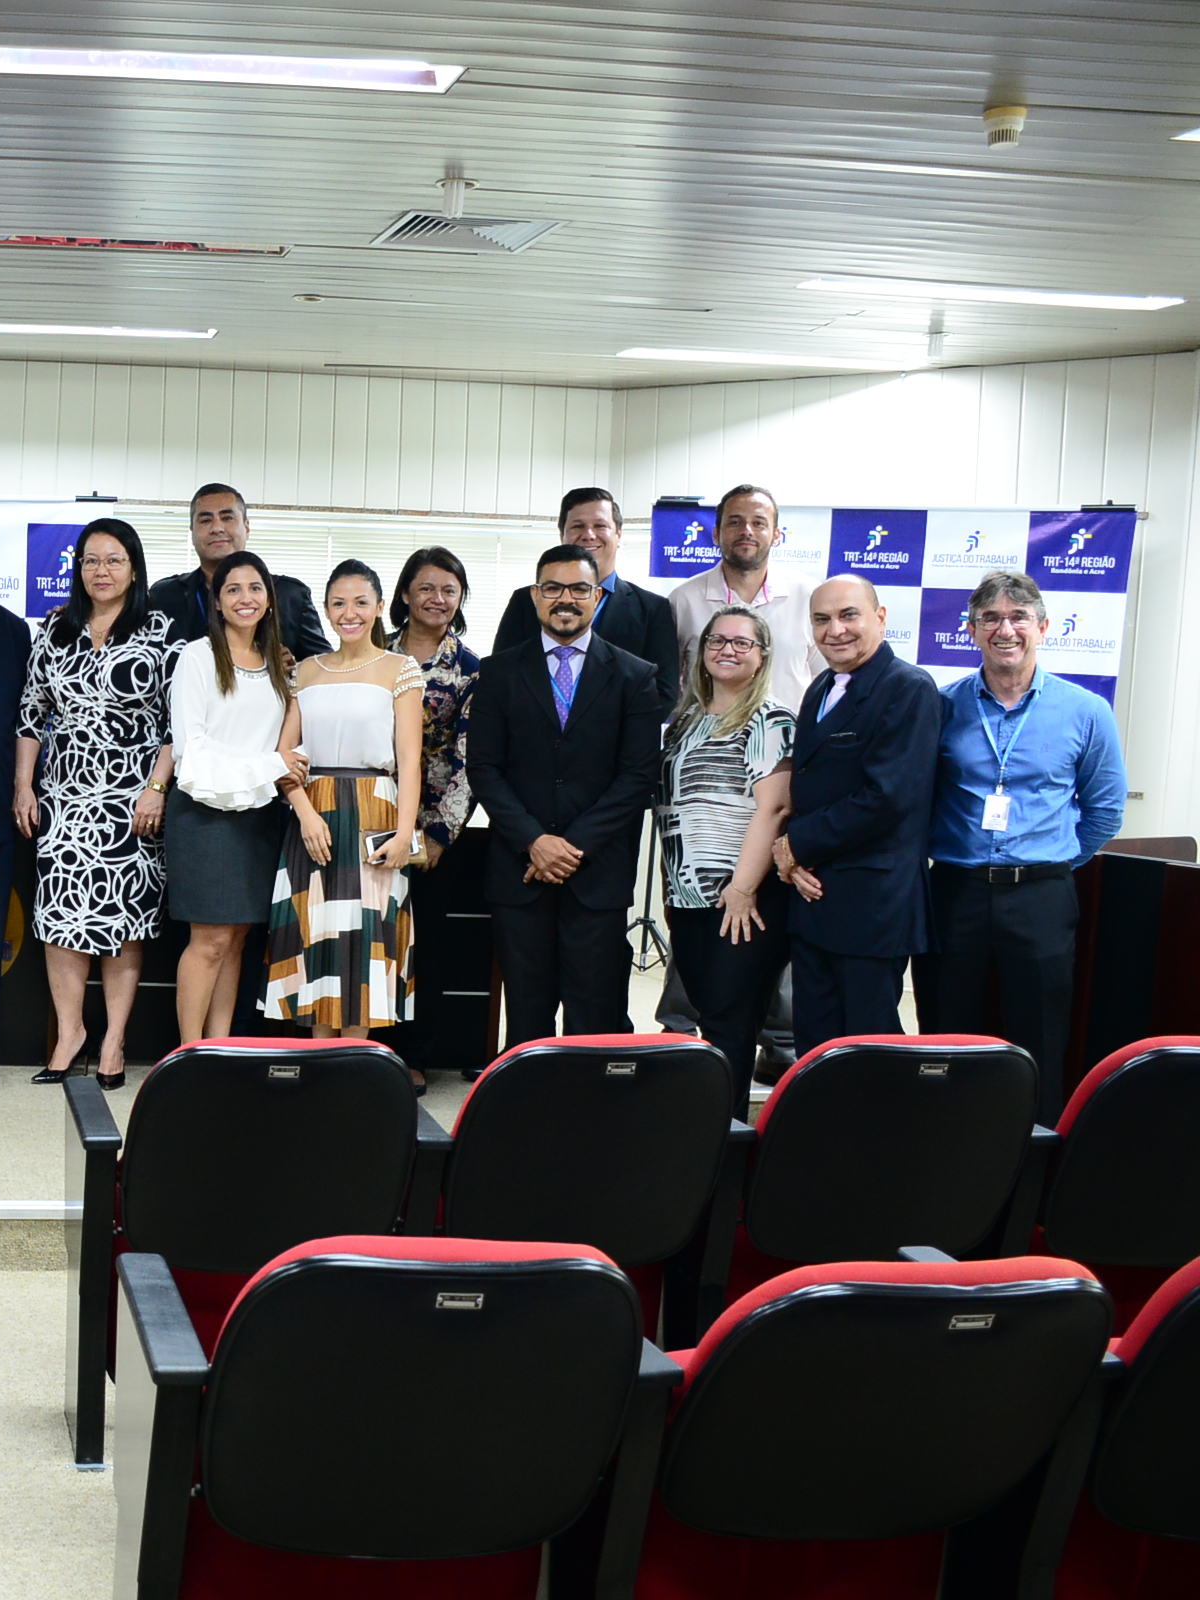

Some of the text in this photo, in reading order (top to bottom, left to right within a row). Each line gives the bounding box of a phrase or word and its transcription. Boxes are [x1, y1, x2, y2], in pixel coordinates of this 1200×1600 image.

[663, 546, 694, 556] TRT-14ª
[772, 549, 821, 559] DO TRABALHO
[844, 551, 909, 563] TRT-14ª REGIÃO
[932, 553, 1018, 564] JUSTIÇA DO TRABALHO
[1043, 555, 1116, 568] TRT-14ª REGIÃO
[36, 577, 70, 589] TRT-14ª
[934, 632, 969, 644] TRT-14ª
[1060, 637, 1070, 647] DO
[1072, 638, 1116, 649] TRABALHO
[941, 643, 972, 651] Rondônia
